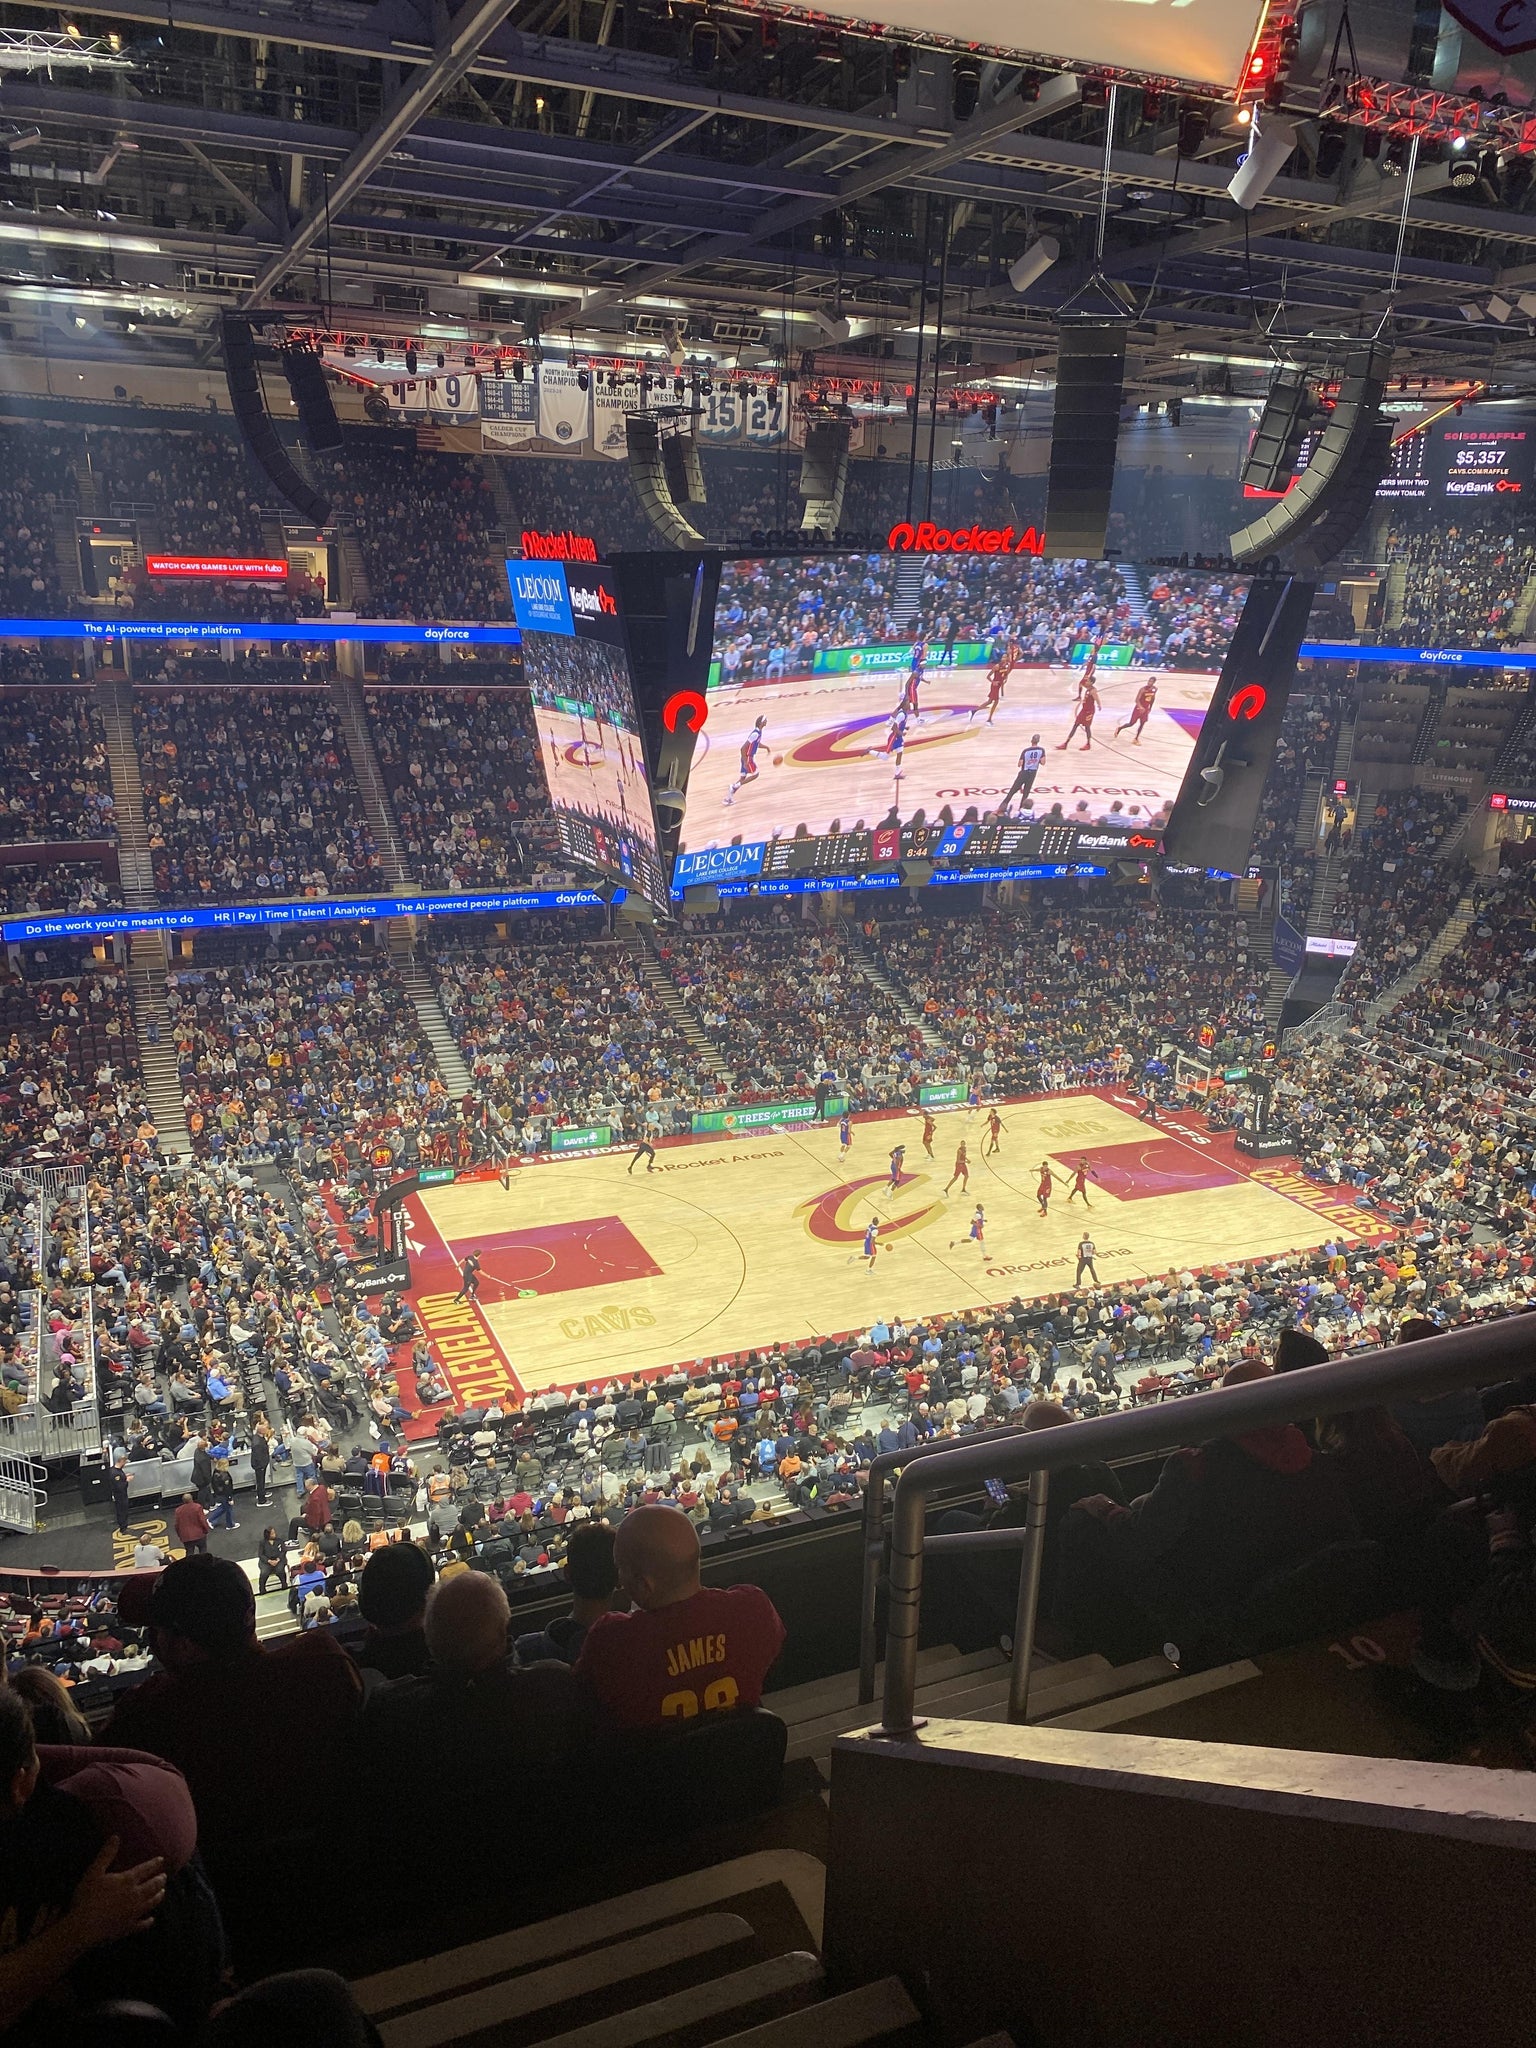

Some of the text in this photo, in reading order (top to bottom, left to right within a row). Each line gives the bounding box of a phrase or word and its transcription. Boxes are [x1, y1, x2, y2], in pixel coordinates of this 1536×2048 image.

[545, 368, 561, 376] NORTH
[446, 376, 461, 408] 9
[595, 386, 622, 397] CALDER
[596, 398, 638, 410] CHAMPIONS
[707, 395, 736, 427] 15
[751, 399, 783, 431] 27
[1479, 432, 1527, 440] RAFFLE
[1456, 450, 1506, 466] $5,357
[1448, 468, 1510, 476] CAVS.COM/RAFFLE
[1399, 479, 1414, 487] WITH
[1414, 479, 1430, 487] TWO
[1446, 481, 1495, 494] KeyBank
[915, 522, 1013, 553] Rocket
[530, 529, 598, 563] Rocket Arena
[152, 561, 180, 571] WATCH
[180, 563, 200, 571] CAVS
[200, 564, 228, 572] GAMES
[245, 564, 264, 573] WITH
[264, 563, 283, 573] fubo
[569, 585, 602, 613] KeyBank
[83, 623, 242, 637] The AI-powered people platform
[424, 627, 470, 641] dayforce
[865, 652, 902, 665] TREES
[1419, 650, 1464, 662] dayforce
[1432, 773, 1473, 784] LITEHOUSE
[1071, 785, 1162, 798] Arena
[902, 831, 912, 839] 20
[931, 830, 941, 838] 21
[1077, 834, 1130, 848] KeyBank
[879, 846, 893, 858] 35
[942, 843, 957, 854] 30
[906, 847, 928, 858] 8:44
[678, 846, 761, 875] LECOM
[695, 870, 708, 878] LAKE
[718, 865, 738, 874] COLLEGE
[935, 868, 1043, 882] The AI-powered people platform
[718, 886, 743, 896] you're
[769, 883, 777, 891] to
[778, 882, 790, 891] do
[804, 881, 816, 890] HR
[821, 881, 835, 892] Pay
[840, 879, 858, 889] Time
[396, 896, 540, 913] The AI-powered people platform
[556, 892, 603, 905] dayforc
[214, 905, 377, 924] HR Pay Time Talent Analytics
[26, 914, 194, 935] Do the work you're meant to do
[1275, 935, 1303, 952] LECOM
[929, 1093, 949, 1101] DAVEY
[737, 1111, 771, 1125] TREES
[770, 1111, 781, 1121] for
[562, 1136, 589, 1147] DAVEY
[1258, 1139, 1282, 1150] KeyBank
[537, 1142, 640, 1162] TRUSTEDSEC
[663, 1150, 785, 1173] Rocket Arena
[1249, 1169, 1393, 1238] CAVALIERS
[1002, 1255, 1076, 1276] Rocket
[352, 1276, 388, 1291] eyBank
[559, 1305, 657, 1340] CAVS
[416, 1291, 516, 1403] CLEVELAND
[666, 1633, 727, 1678] JAMES
[1327, 1635, 1387, 1671] 10
